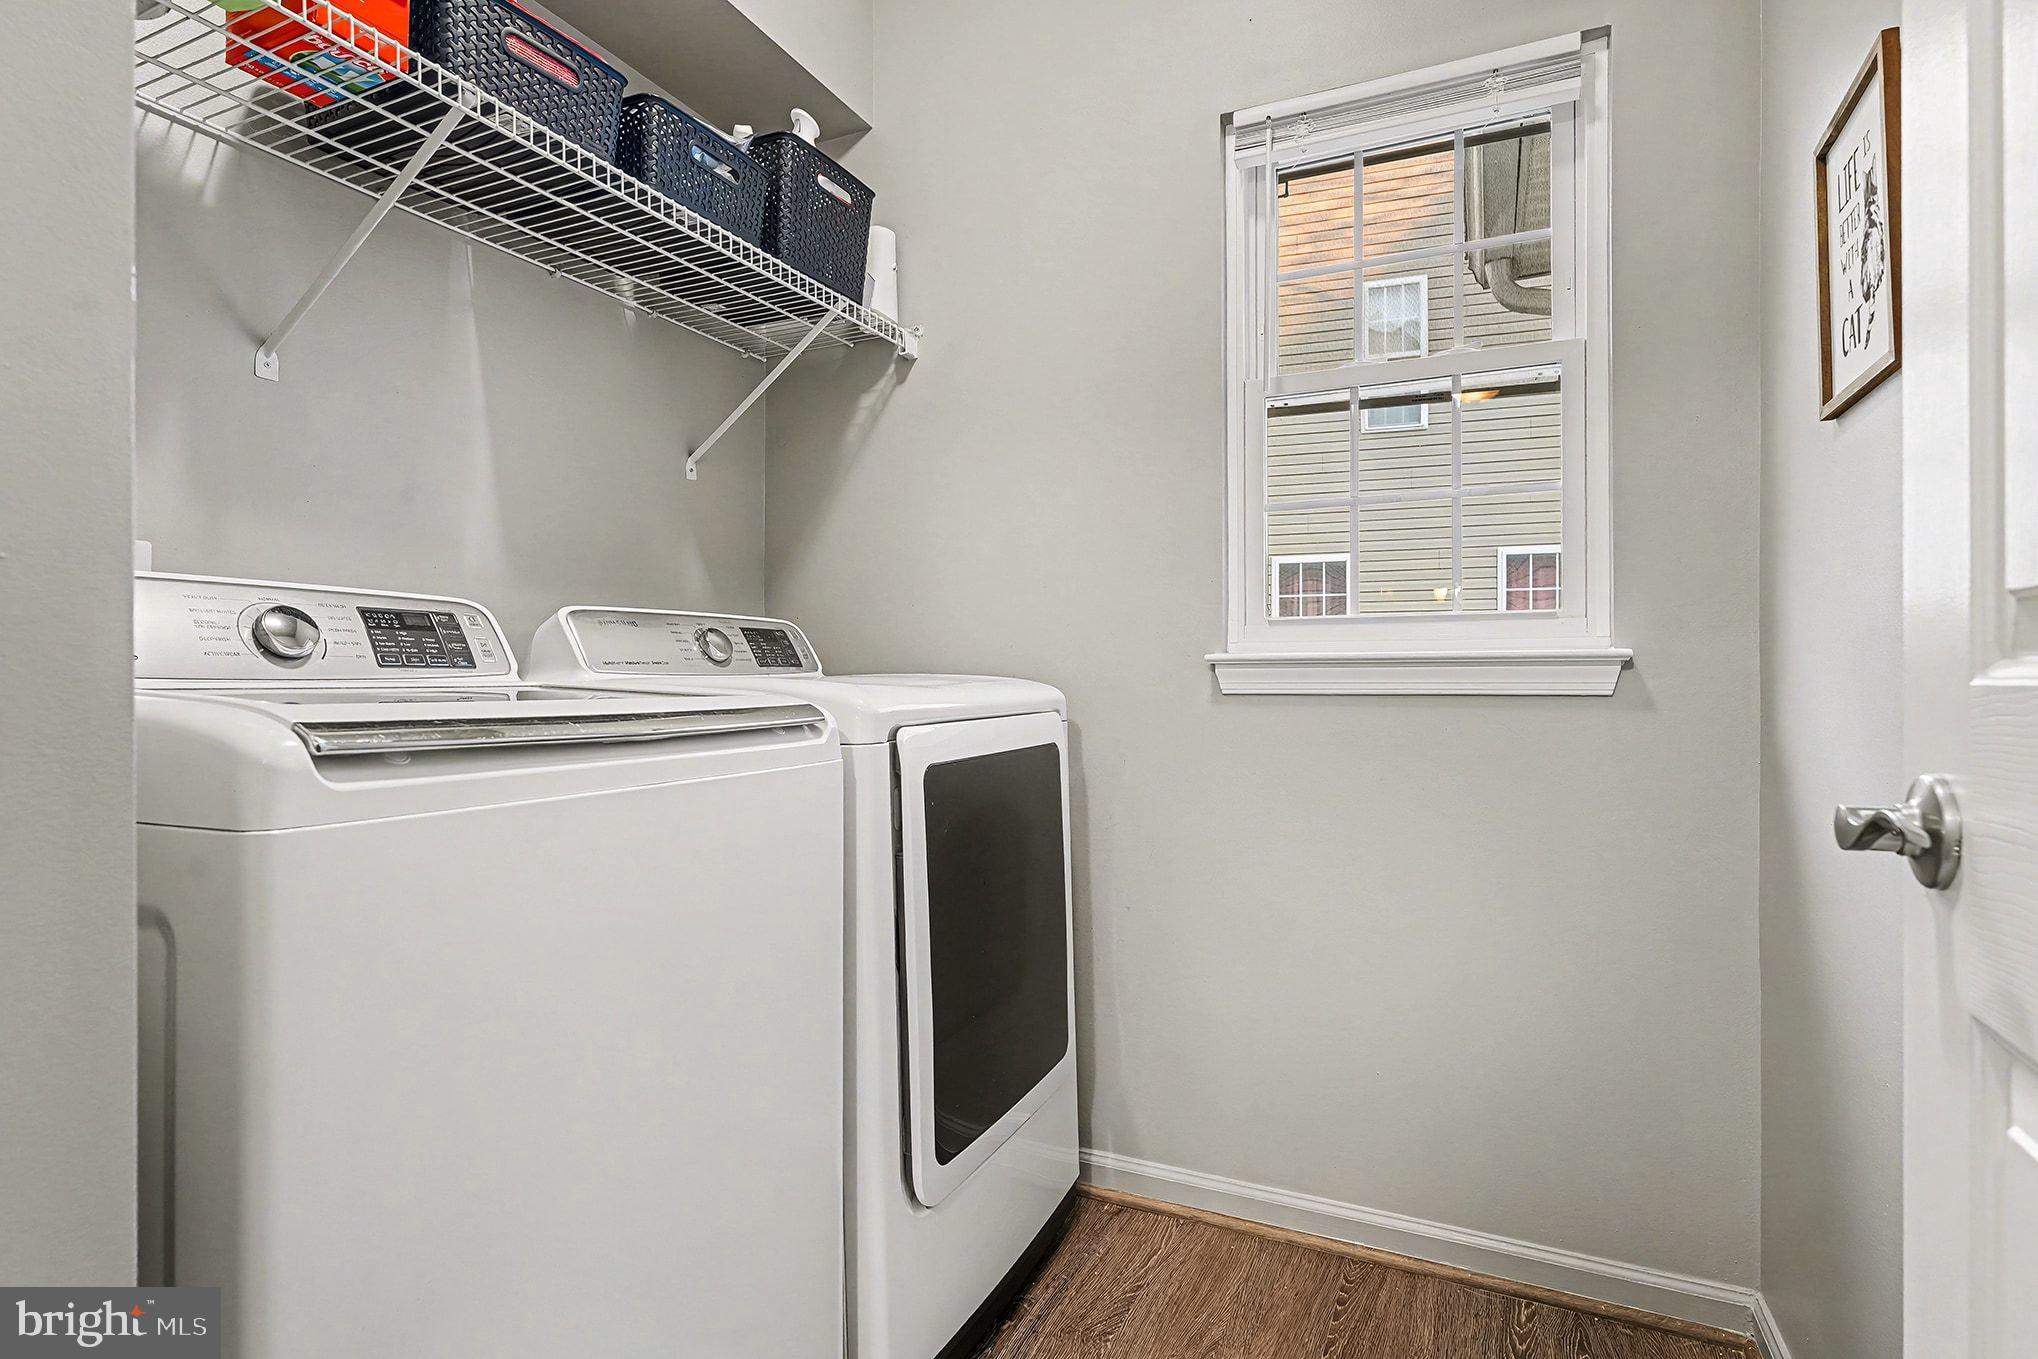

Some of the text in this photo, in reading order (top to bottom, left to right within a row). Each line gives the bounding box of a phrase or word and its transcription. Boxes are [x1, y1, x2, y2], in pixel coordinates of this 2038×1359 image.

[1837, 128, 1871, 214] LIFE IS
[1839, 201, 1861, 248] BETTER
[1840, 238, 1860, 276] WITH
[1848, 279, 1854, 302] A
[1841, 303, 1863, 357] CAT
